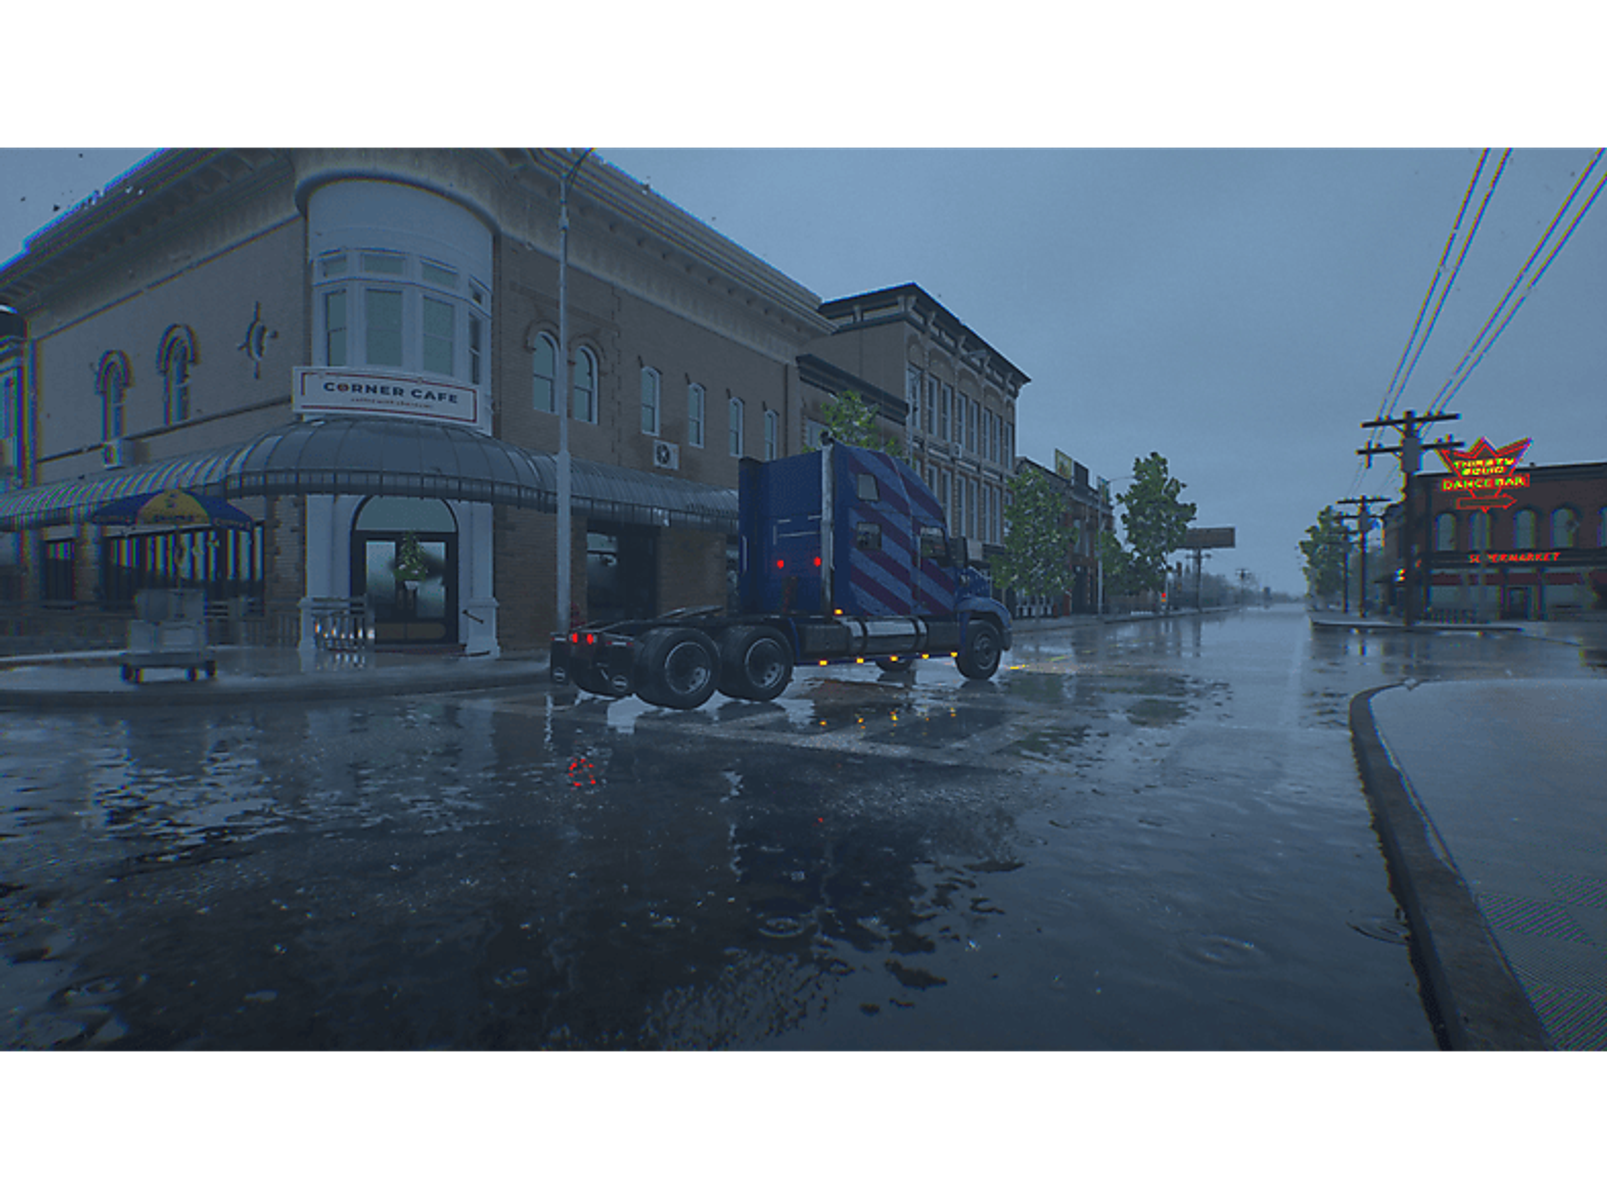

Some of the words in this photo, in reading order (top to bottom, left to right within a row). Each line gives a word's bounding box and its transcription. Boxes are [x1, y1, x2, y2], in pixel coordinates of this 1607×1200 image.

[323, 381, 404, 397] CORNER
[411, 388, 458, 404] CAFE
[1443, 478, 1492, 490] DANCE
[1495, 476, 1525, 487] BAR
